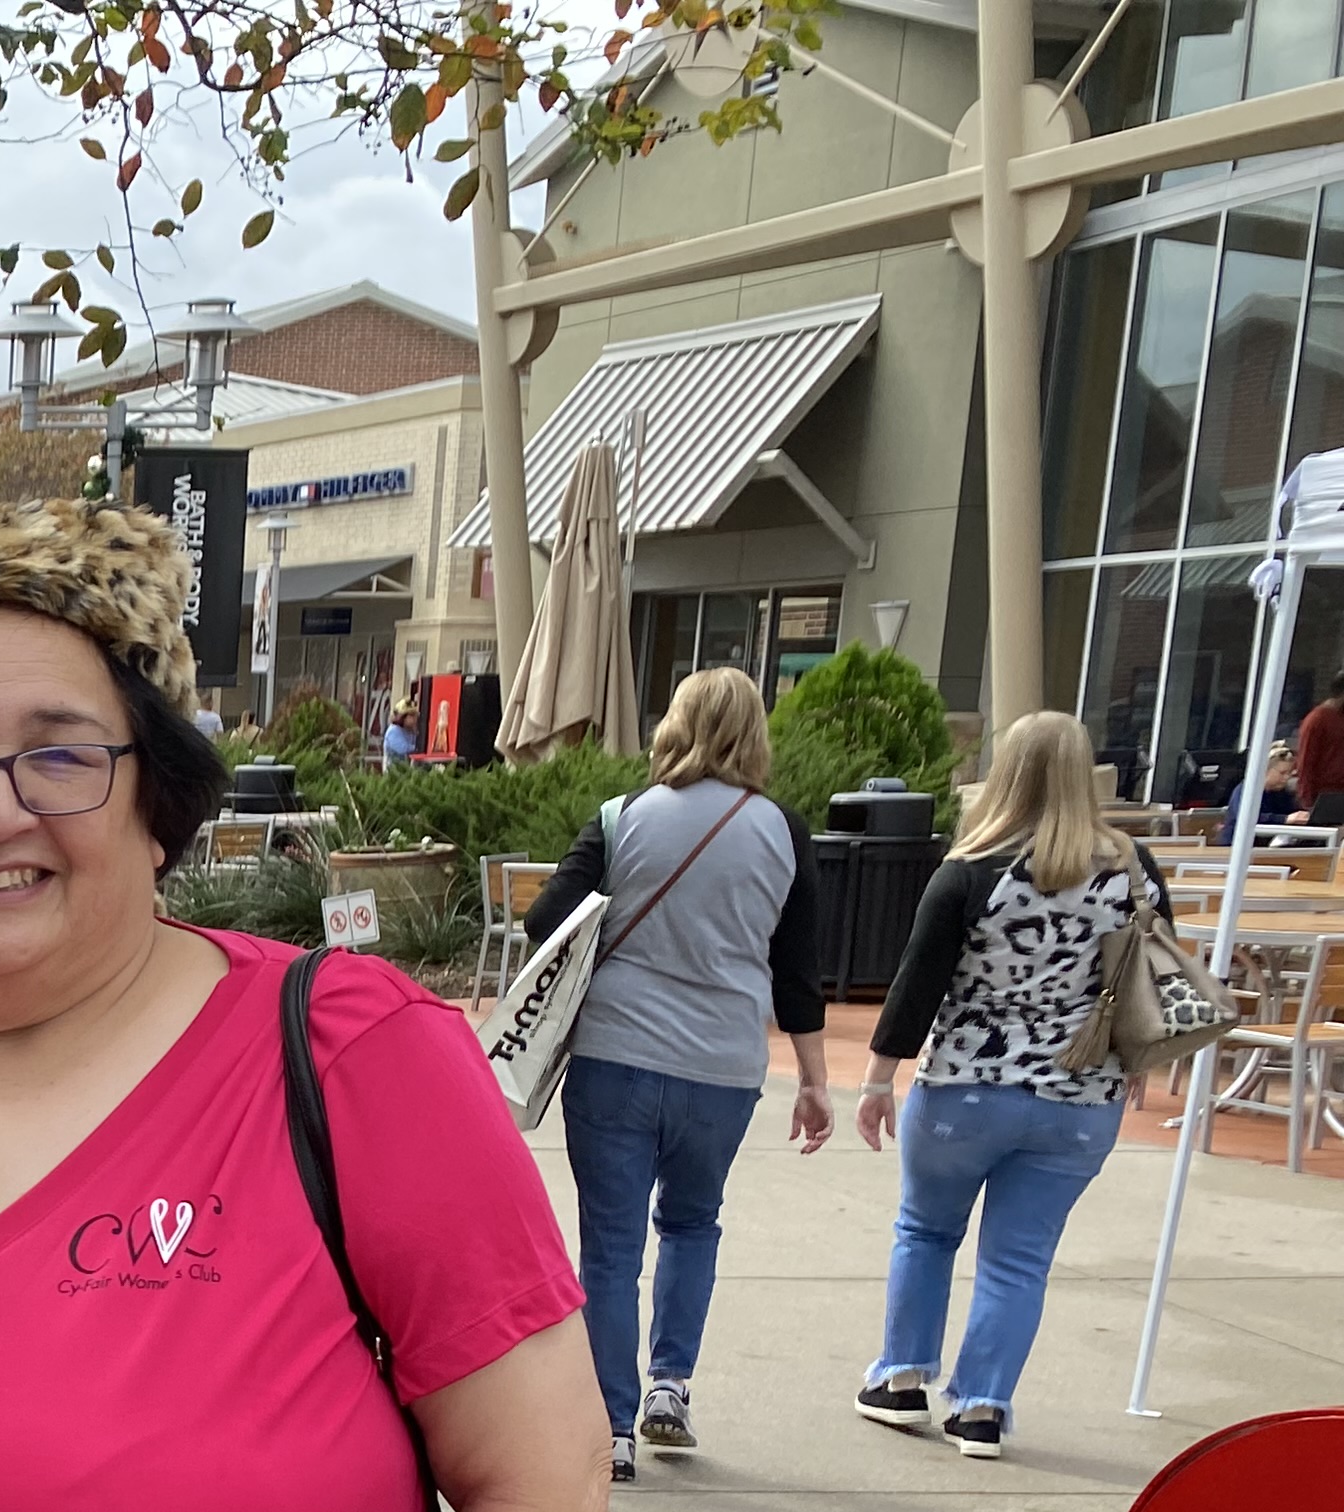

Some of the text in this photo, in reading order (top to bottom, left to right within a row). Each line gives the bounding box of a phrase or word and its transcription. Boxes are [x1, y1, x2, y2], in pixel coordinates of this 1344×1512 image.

[321, 469, 406, 498] HILFIGER
[188, 490, 206, 548] BATH
[69, 1194, 222, 1274] CWC
[189, 1264, 221, 1283] Club
